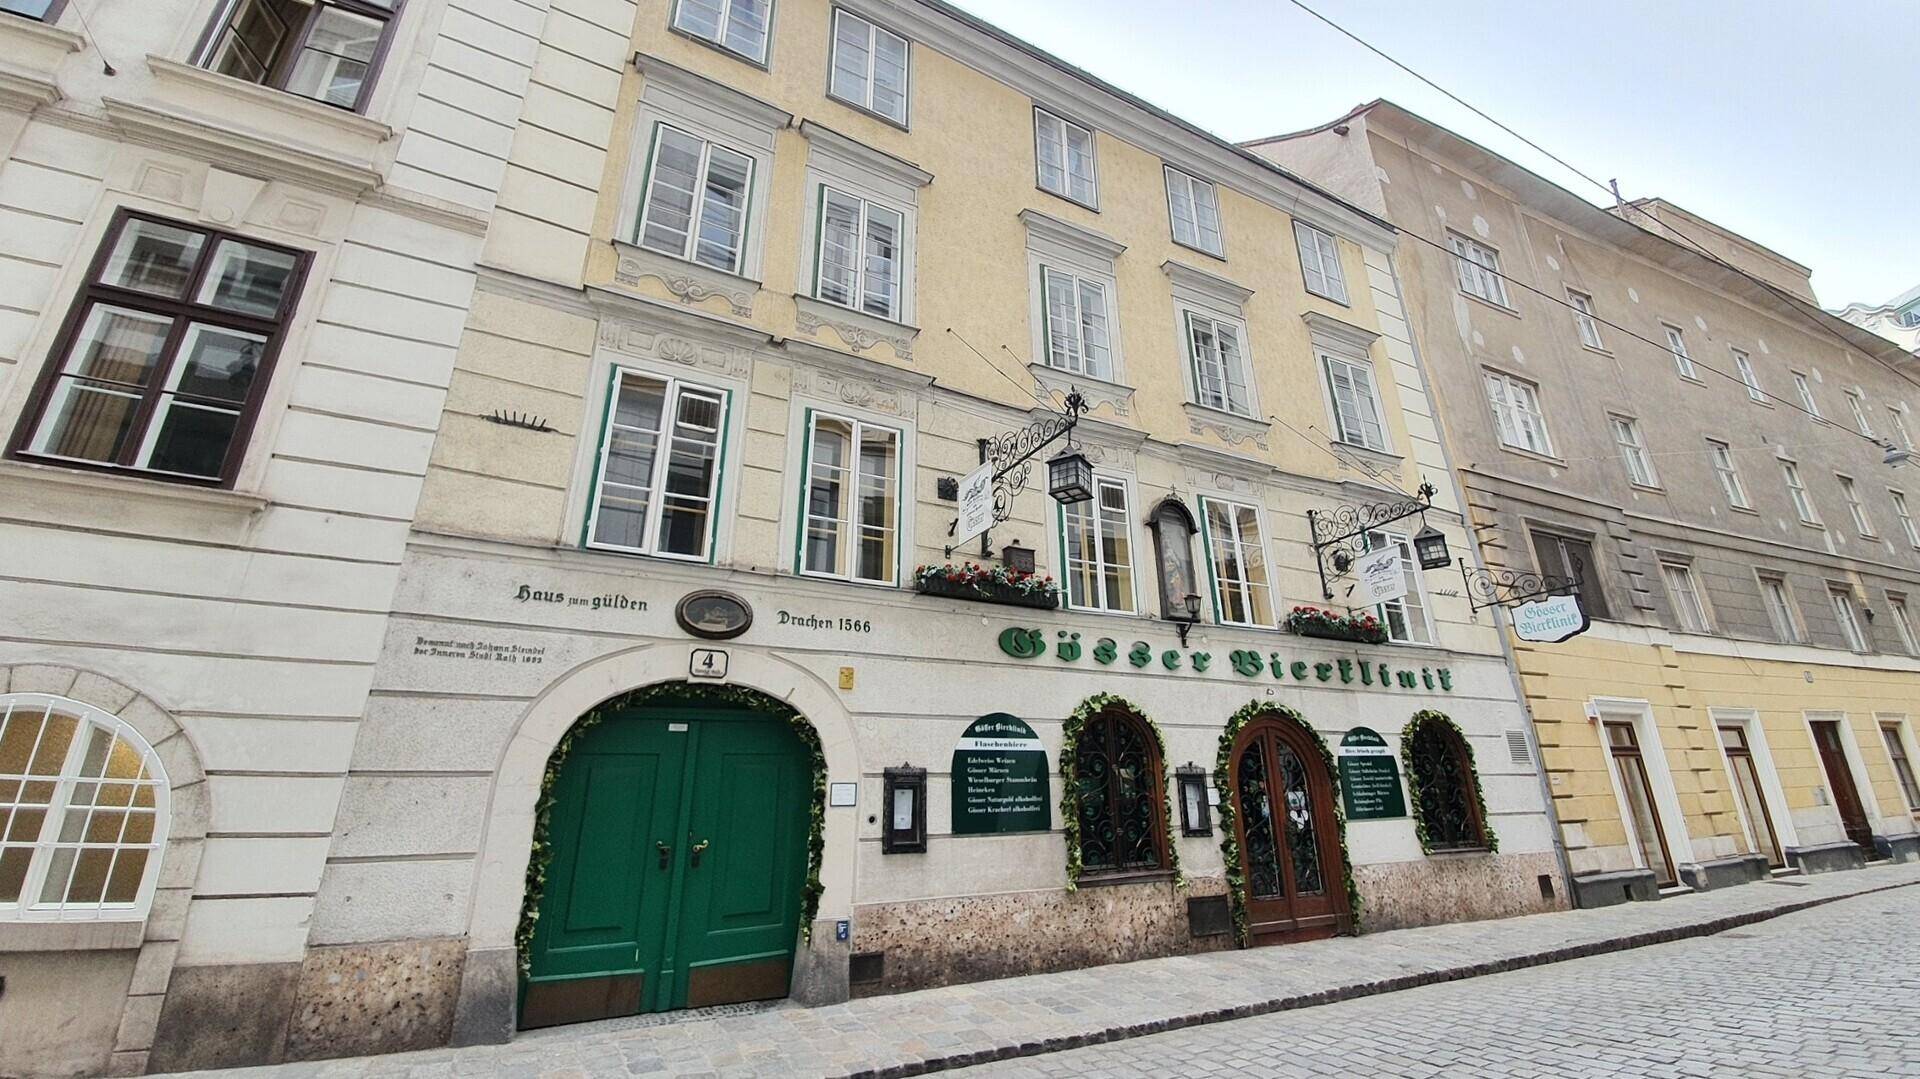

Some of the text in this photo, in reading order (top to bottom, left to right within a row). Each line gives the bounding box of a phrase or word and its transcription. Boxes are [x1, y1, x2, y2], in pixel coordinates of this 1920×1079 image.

[513, 584, 648, 611] Haus zum gülden
[777, 610, 871, 633] Drachen 1566
[1524, 603, 1567, 619] Gösser
[1520, 613, 1577, 633] Bierklinik
[702, 652, 714, 668] 4
[998, 627, 1454, 692] Gösser Bierklinik
